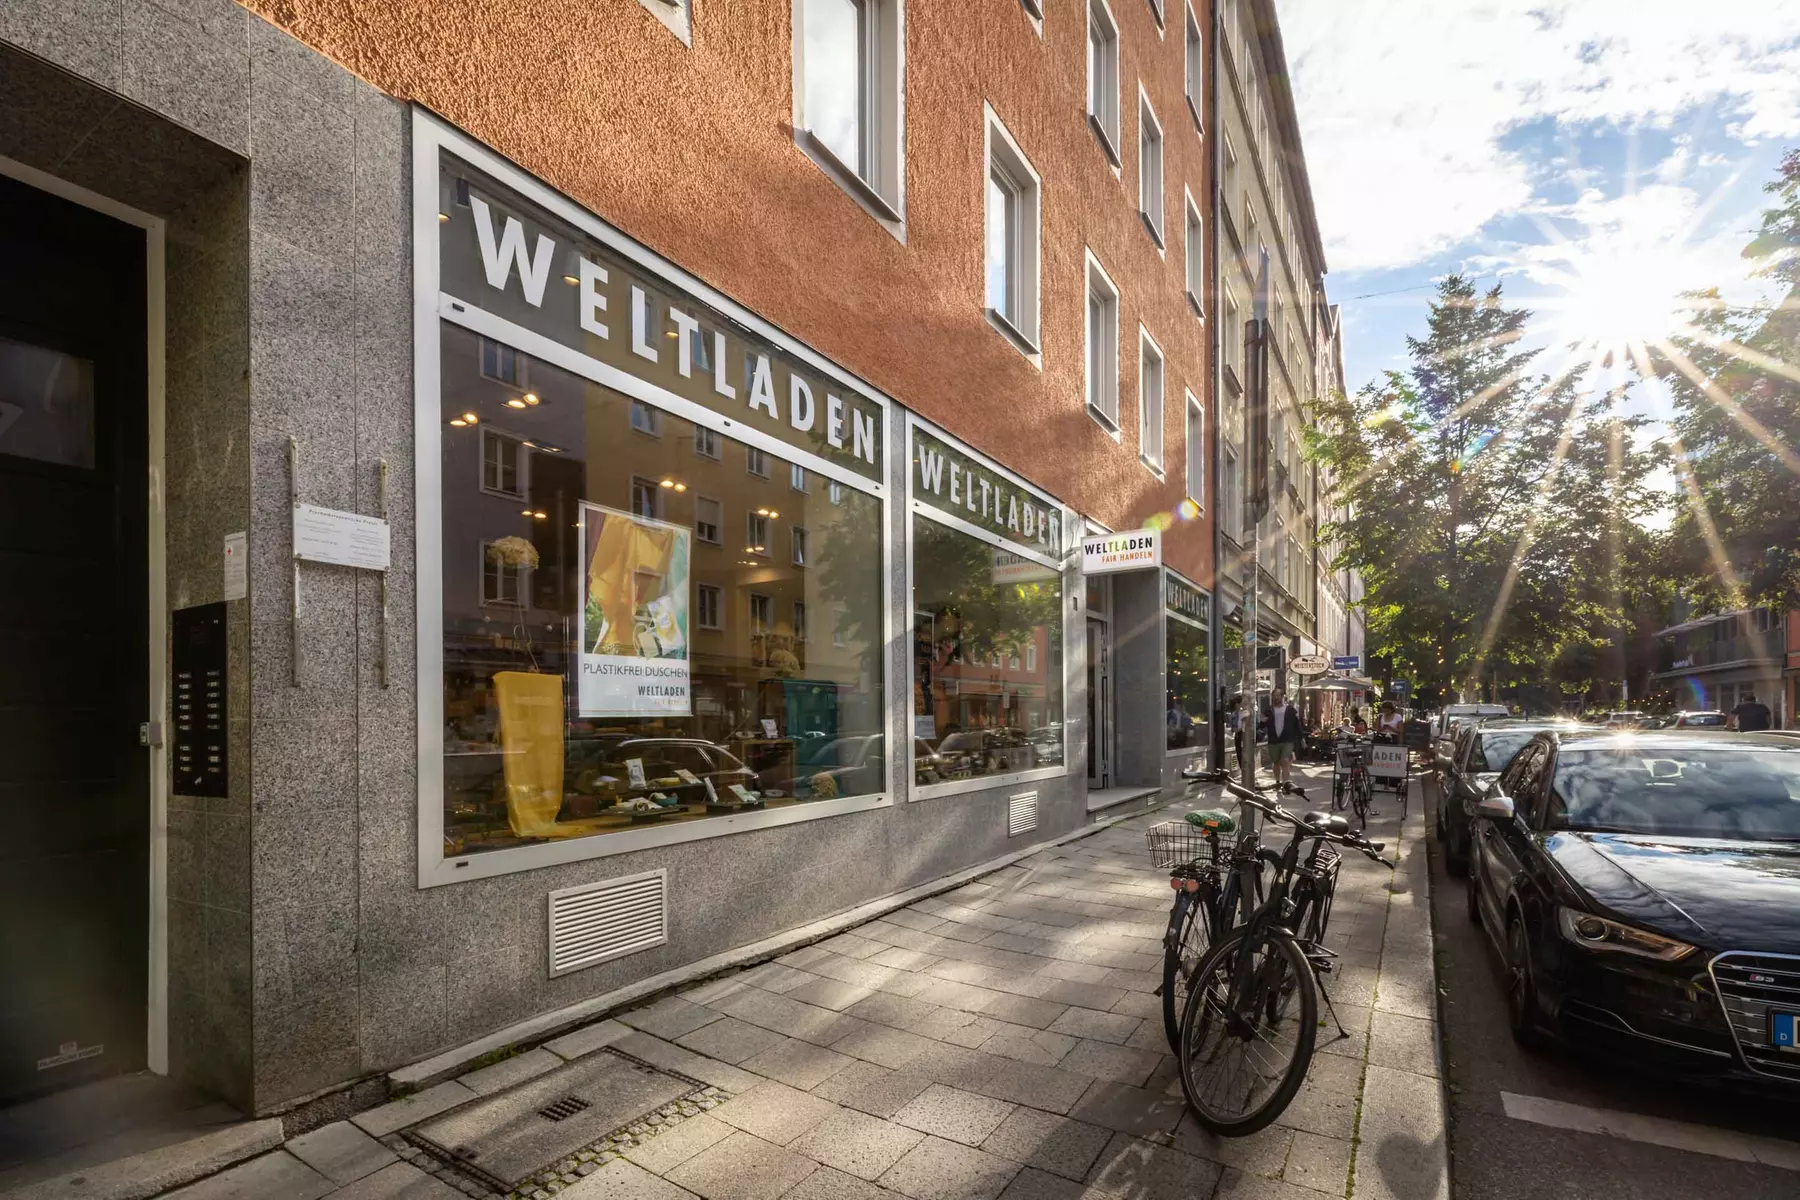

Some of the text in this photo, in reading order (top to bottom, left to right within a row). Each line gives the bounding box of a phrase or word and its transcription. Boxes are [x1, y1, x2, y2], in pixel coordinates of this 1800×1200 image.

[470, 195, 875, 464] WELTLADEN
[919, 444, 1059, 550] WELTLADEN
[1085, 537, 1153, 555] WELTLADEN
[1102, 551, 1153, 563] FAIR HANDELN
[583, 663, 688, 678] PLASTIKFREI DUSCHEN
[638, 685, 685, 697] WELTLADEN
[1780, 1032, 1788, 1041] D
